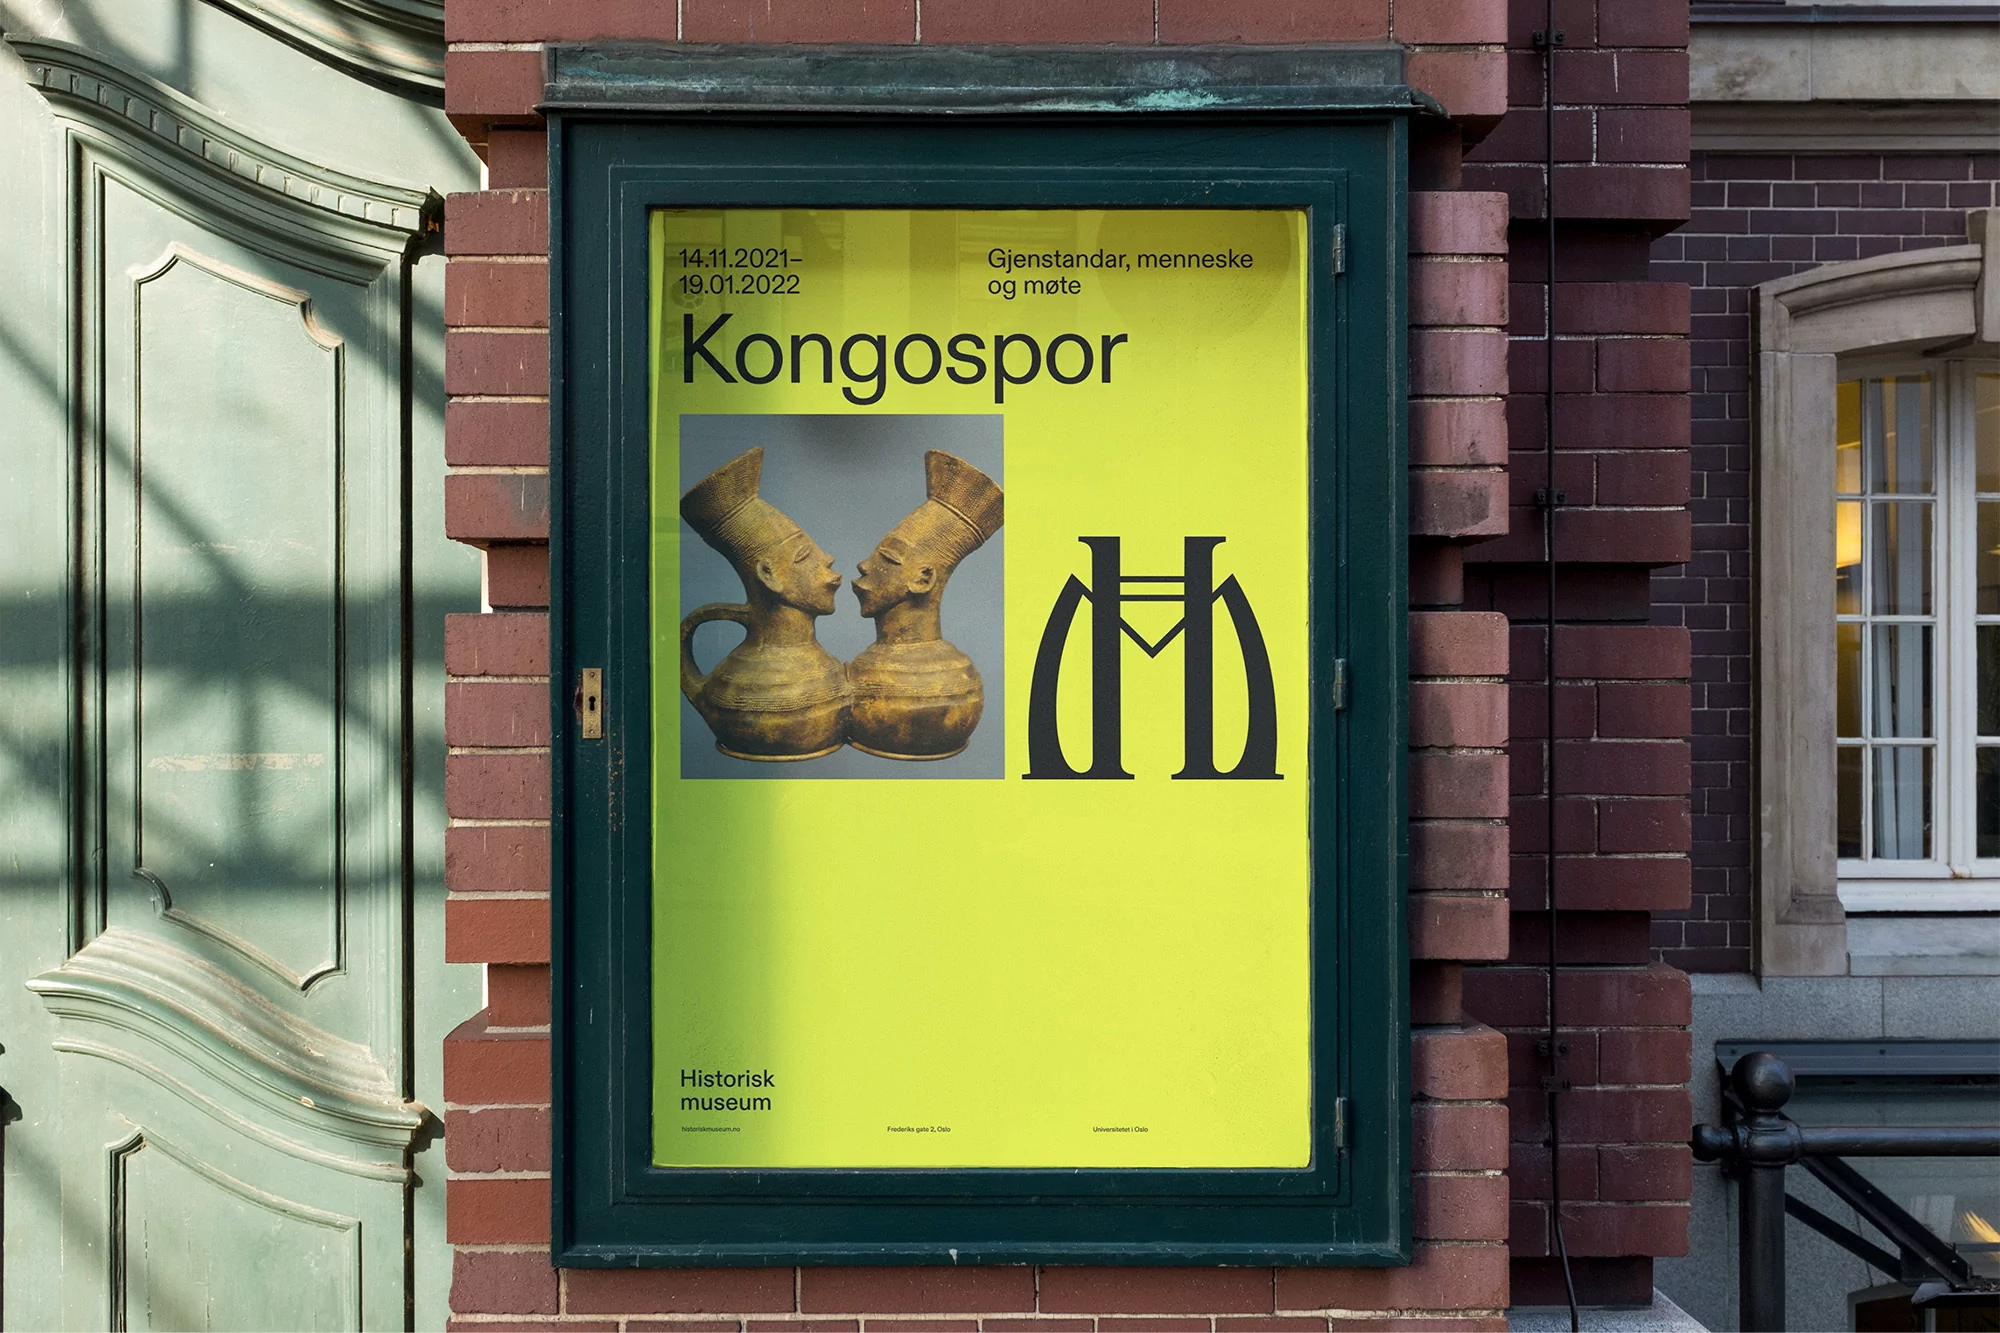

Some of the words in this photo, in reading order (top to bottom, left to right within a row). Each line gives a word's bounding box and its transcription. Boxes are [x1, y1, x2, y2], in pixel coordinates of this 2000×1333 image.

[678, 247, 803, 269] 14.11.2021–
[987, 247, 1131, 273] Gjenstandar,
[1137, 248, 1254, 269] menneske
[678, 274, 801, 295] 19.01.2022
[987, 277, 1017, 299] og
[1024, 276, 1082, 295] møte
[683, 313, 1128, 406] Kongospor
[680, 1069, 776, 1088] Historisk
[680, 1096, 772, 1111] museum
[681, 1125, 741, 1133] historiskmuseum.no
[887, 1125, 915, 1133] Frederiks
[916, 1126, 929, 1134] gate
[930, 1125, 936, 1133] 2,
[937, 1125, 951, 1133] Oslo
[1092, 1125, 1130, 1133] Universitetet
[1134, 1125, 1149, 1133] Oslo
